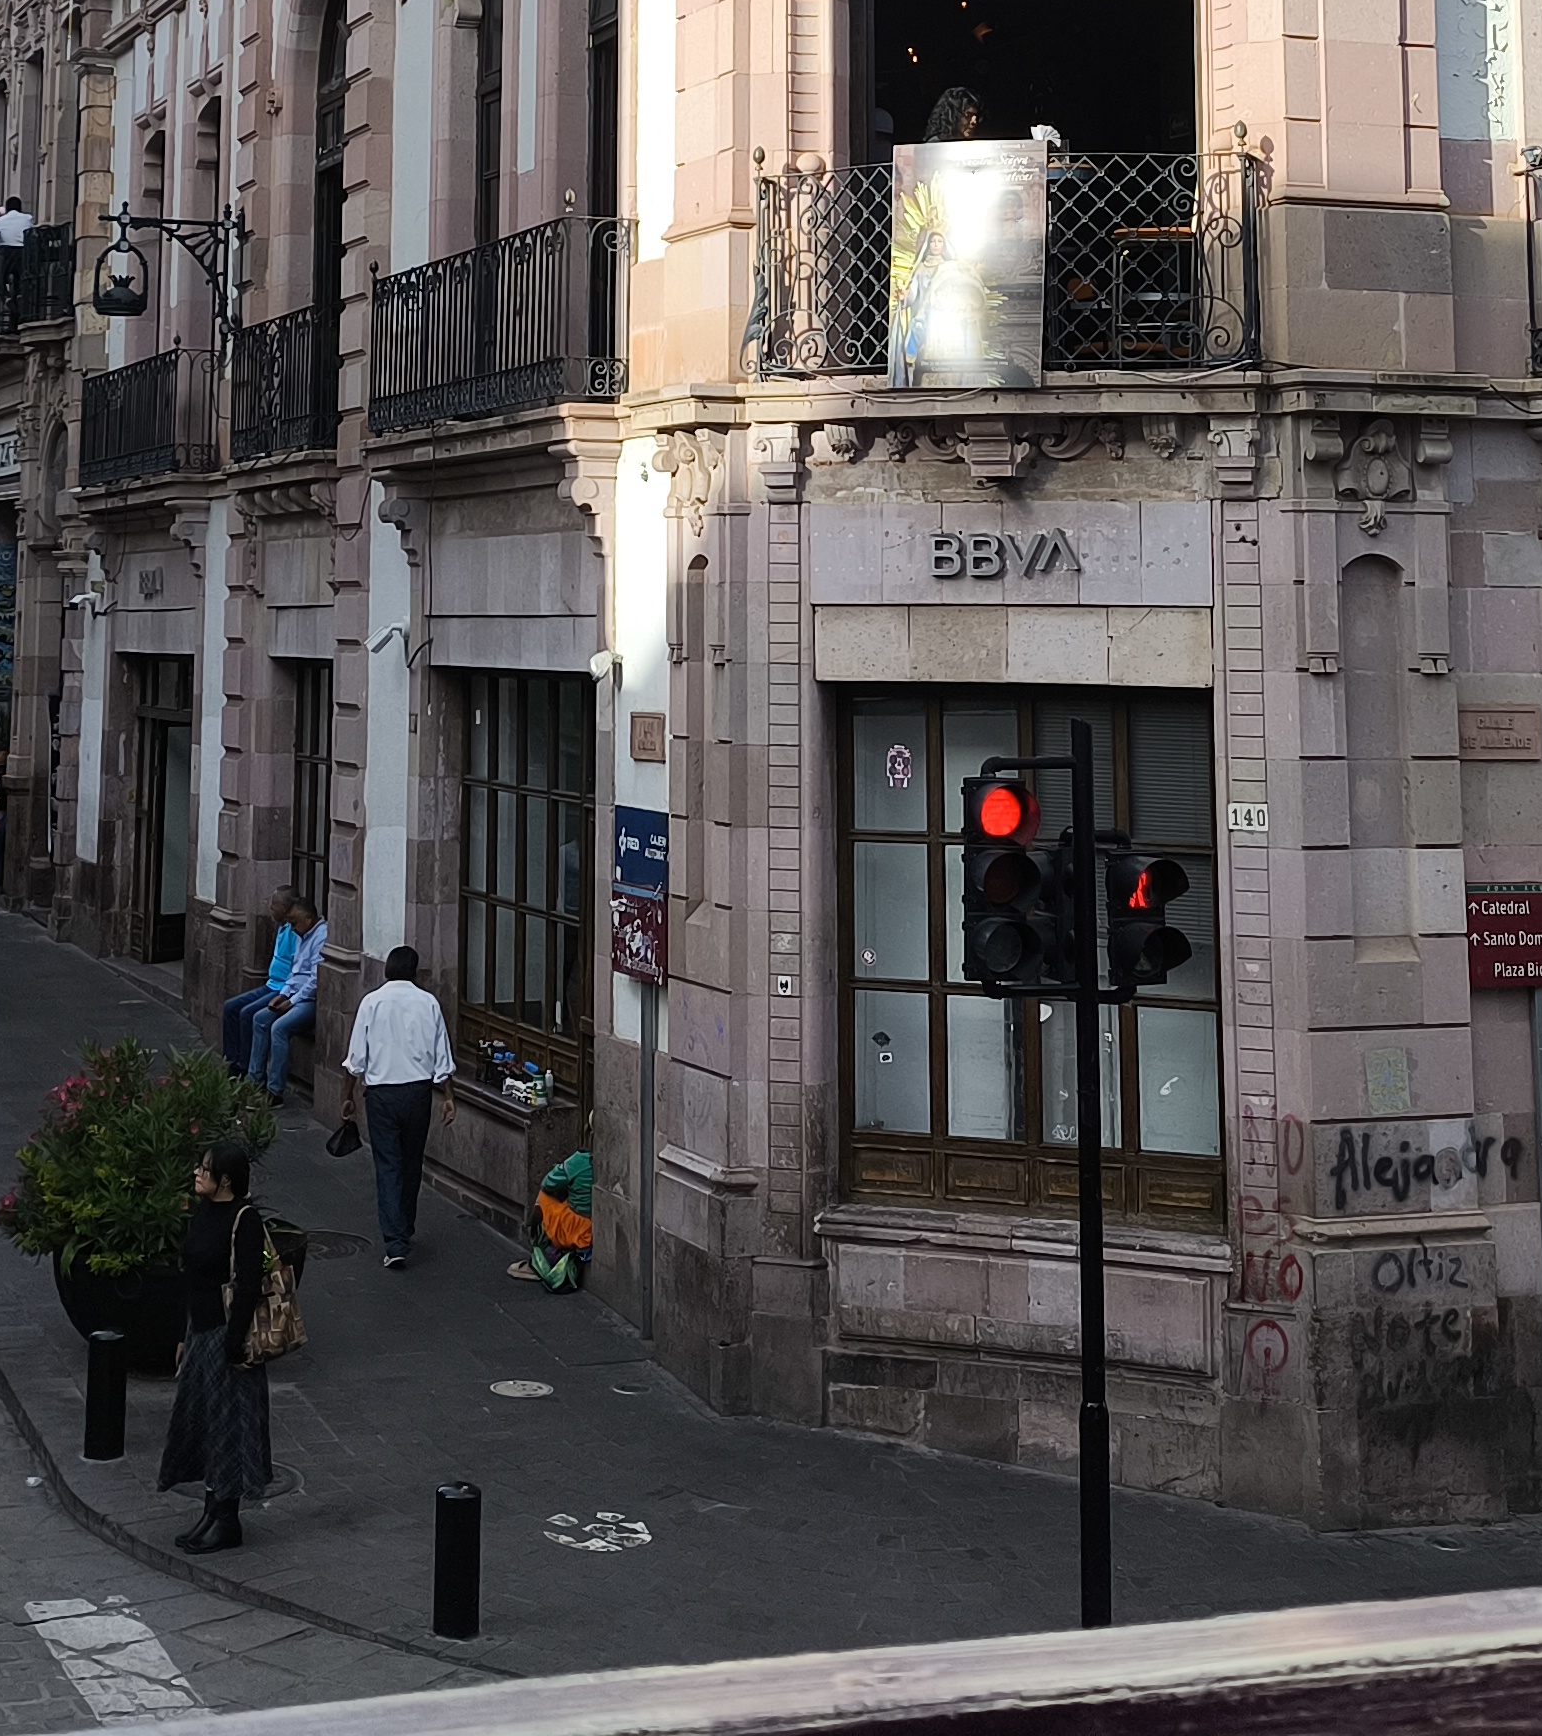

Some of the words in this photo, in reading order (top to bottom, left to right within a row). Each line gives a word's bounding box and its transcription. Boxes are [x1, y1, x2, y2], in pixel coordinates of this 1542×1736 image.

[930, 528, 1081, 579] BBVA
[1231, 808, 1266, 826] 140
[1481, 900, 1531, 915] Catedral
[1483, 931, 1516, 946] Santo
[1494, 962, 1525, 977] Plaza
